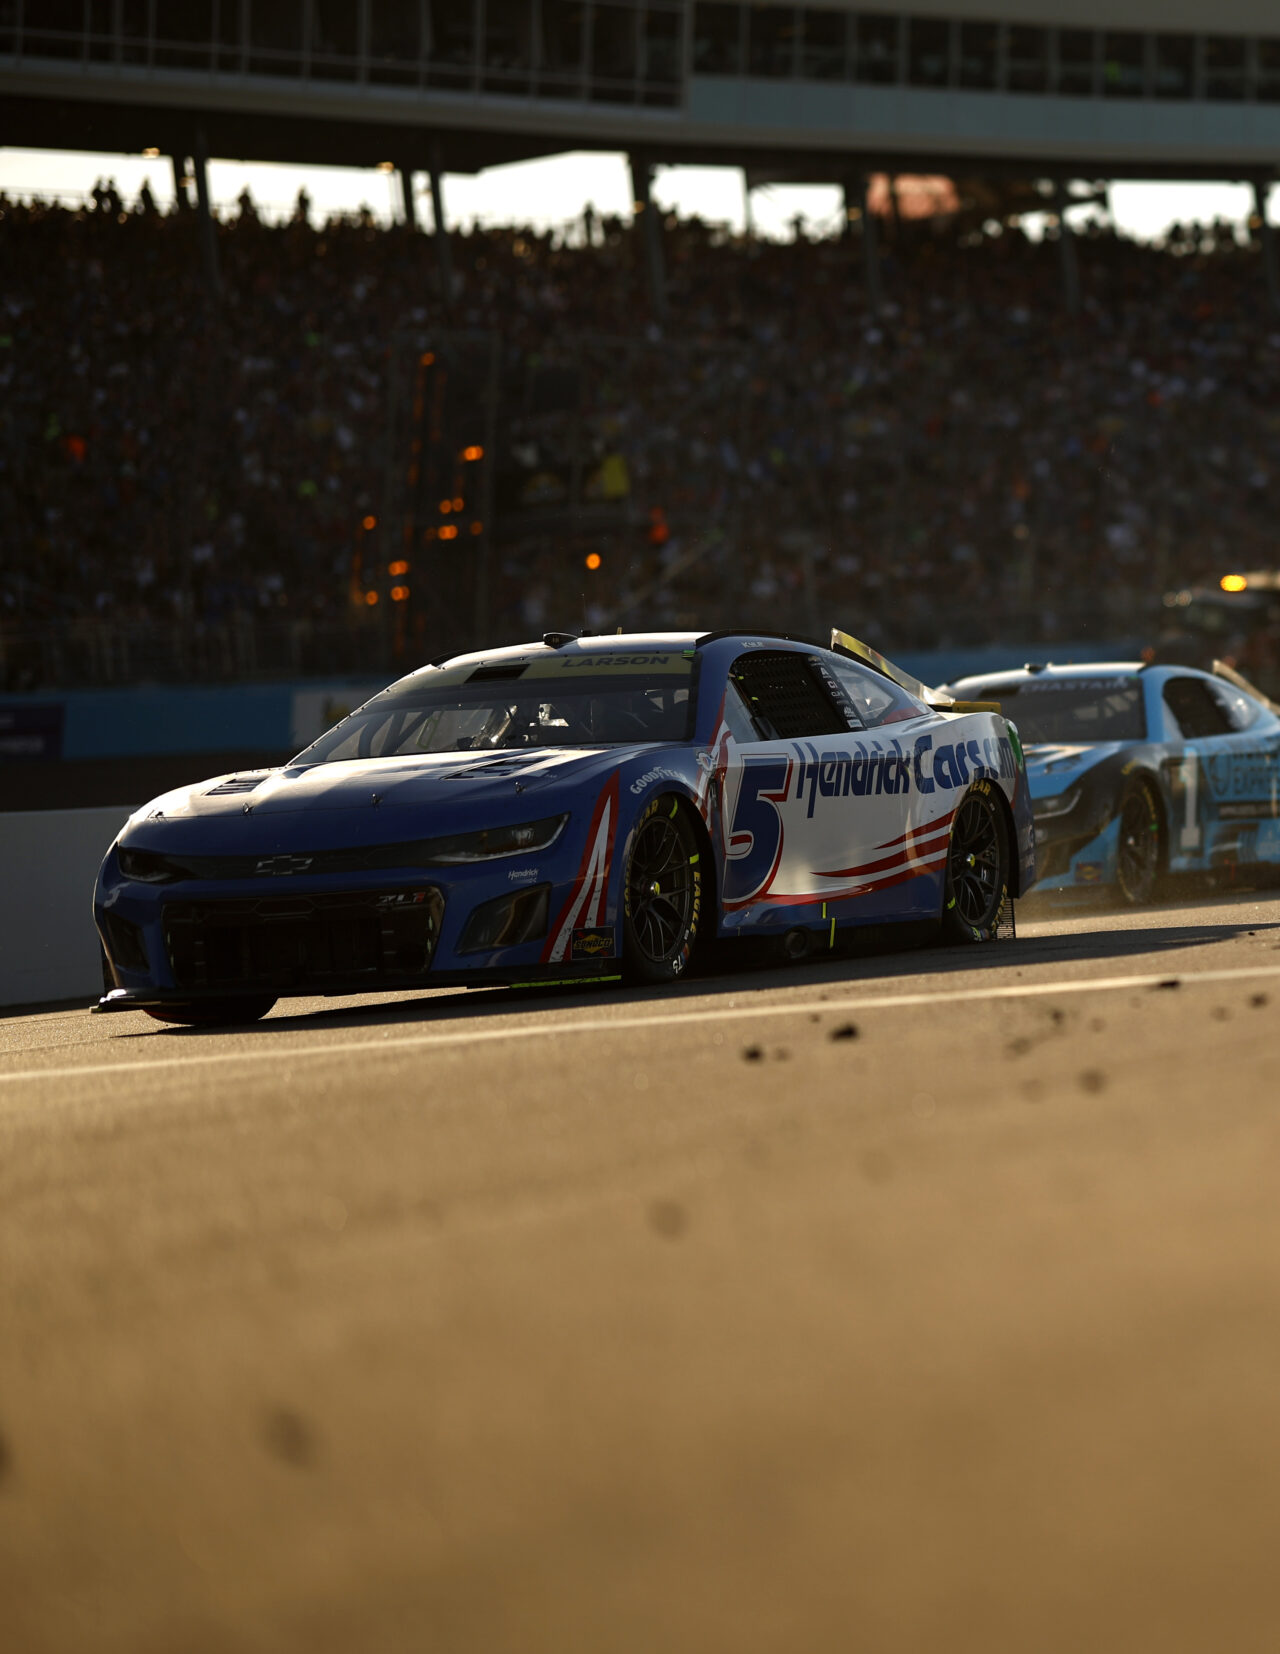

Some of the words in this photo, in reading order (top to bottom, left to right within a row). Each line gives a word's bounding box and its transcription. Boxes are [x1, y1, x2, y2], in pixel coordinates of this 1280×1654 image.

[561, 655, 669, 668] LARSON
[629, 765, 690, 795] GOODYEAR
[791, 734, 1015, 819] HendrickCars.com
[1179, 747, 1200, 848] 1
[721, 752, 794, 906] 5
[692, 870, 702, 937] EAGLE
[573, 937, 614, 950] SUNOCO
